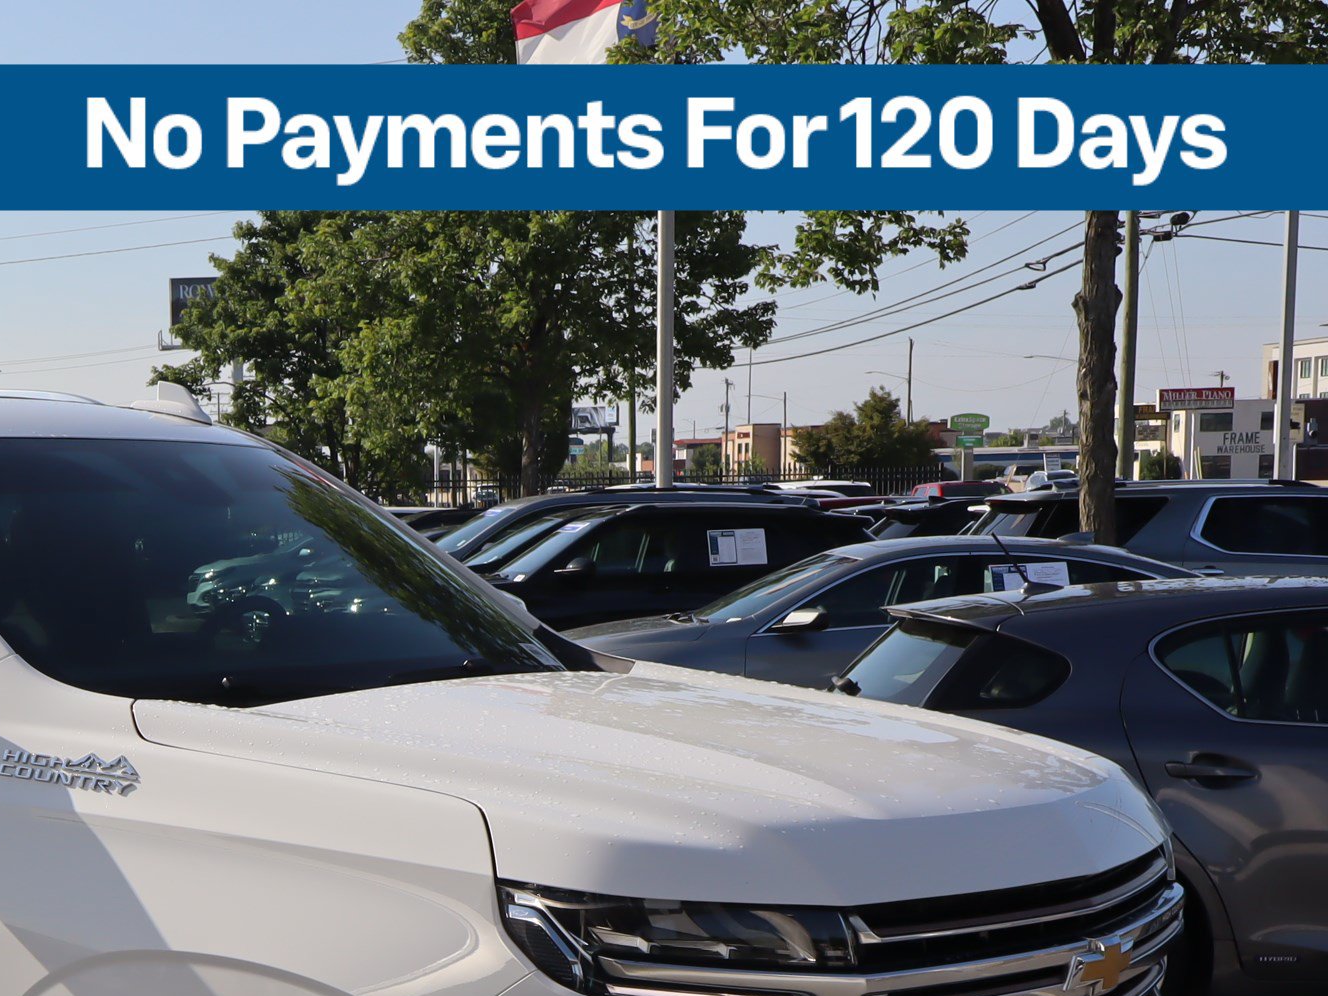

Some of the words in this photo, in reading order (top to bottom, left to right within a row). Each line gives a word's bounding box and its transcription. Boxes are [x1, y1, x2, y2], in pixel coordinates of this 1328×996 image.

[1202, 390, 1232, 400] PIANO
[1222, 432, 1261, 445] FRAME
[1216, 444, 1266, 454] WAREHOUSE
